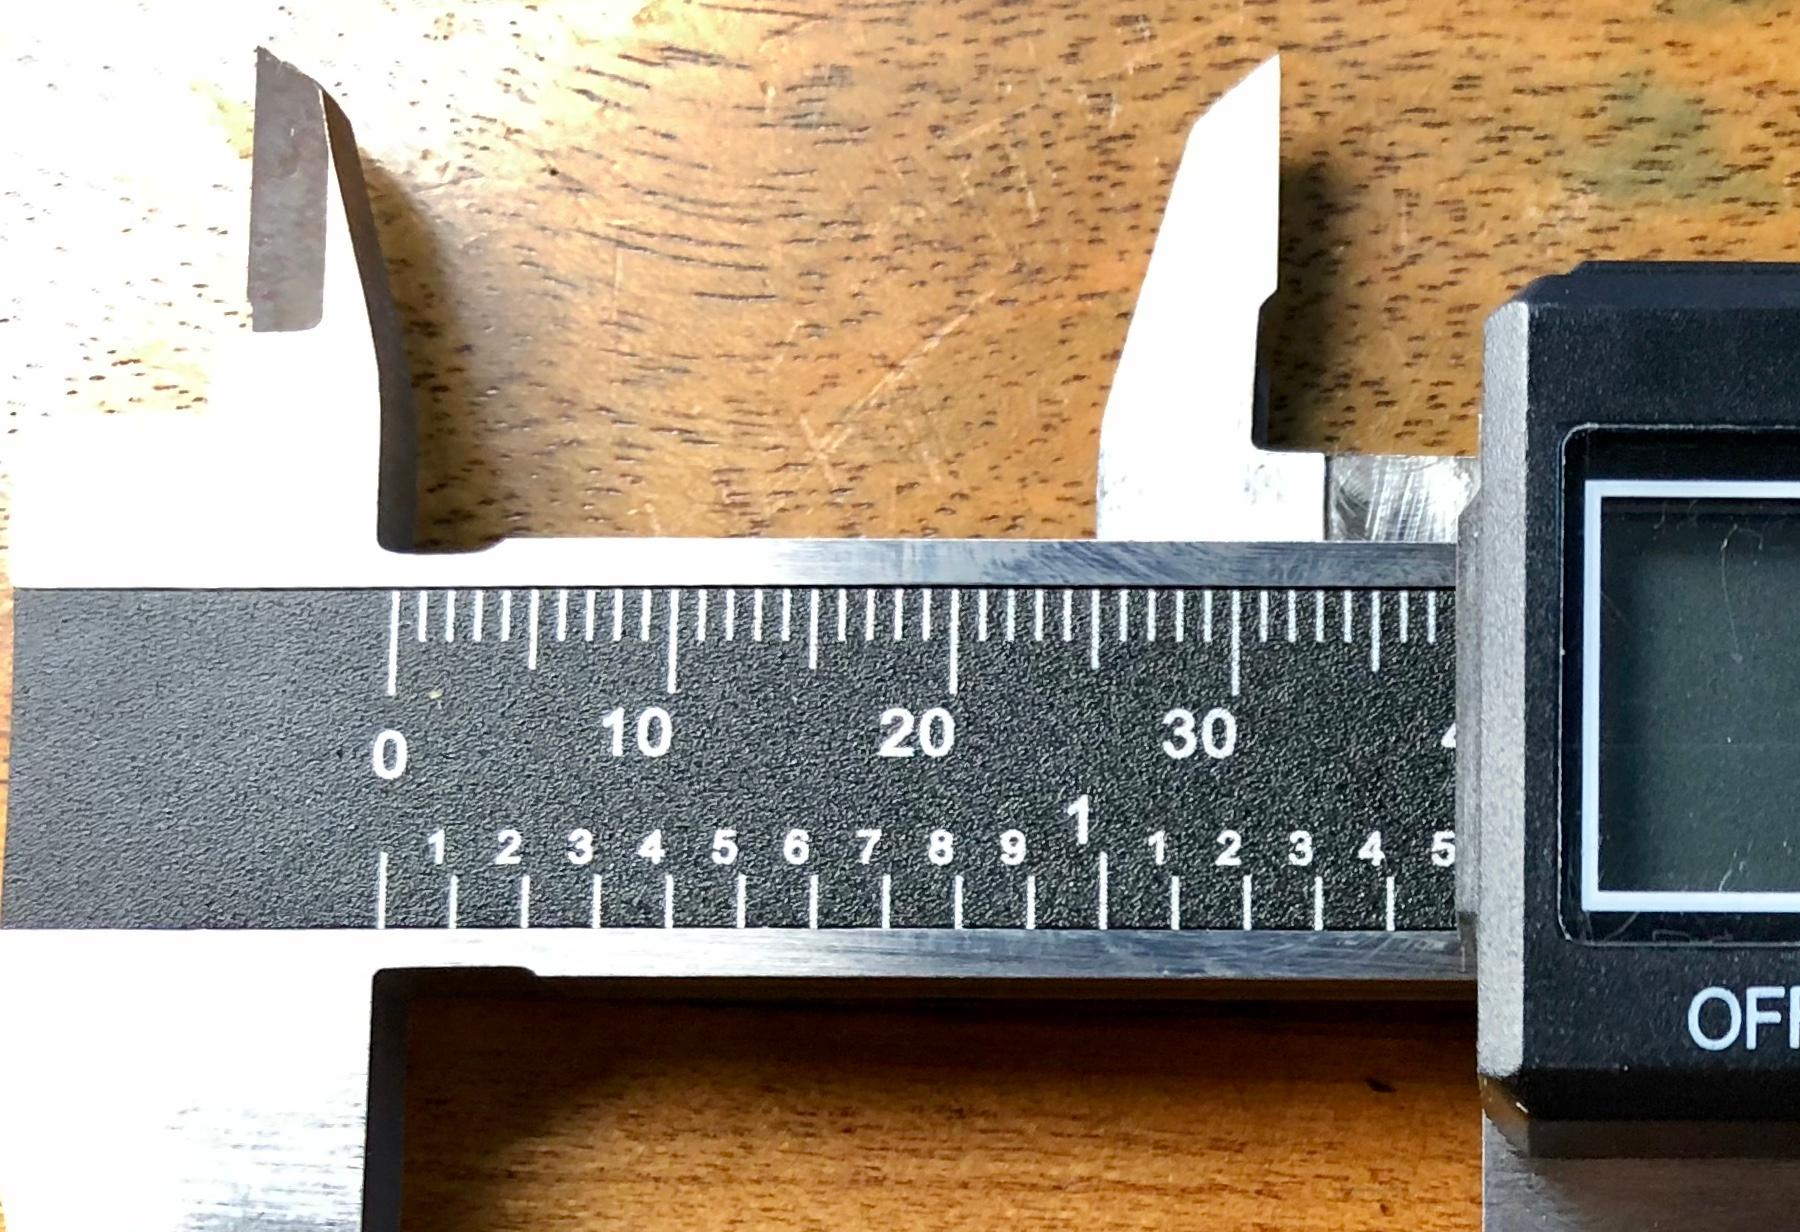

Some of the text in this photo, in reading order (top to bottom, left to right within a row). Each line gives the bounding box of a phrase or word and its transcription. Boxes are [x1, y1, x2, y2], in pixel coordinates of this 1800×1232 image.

[371, 707, 1237, 780] 0 10 20 30
[1064, 795, 1090, 845] 1
[428, 827, 1026, 866] 1 2 3 4 5 6 7 8 9
[1148, 830, 1455, 866] 1 2 3 4 5
